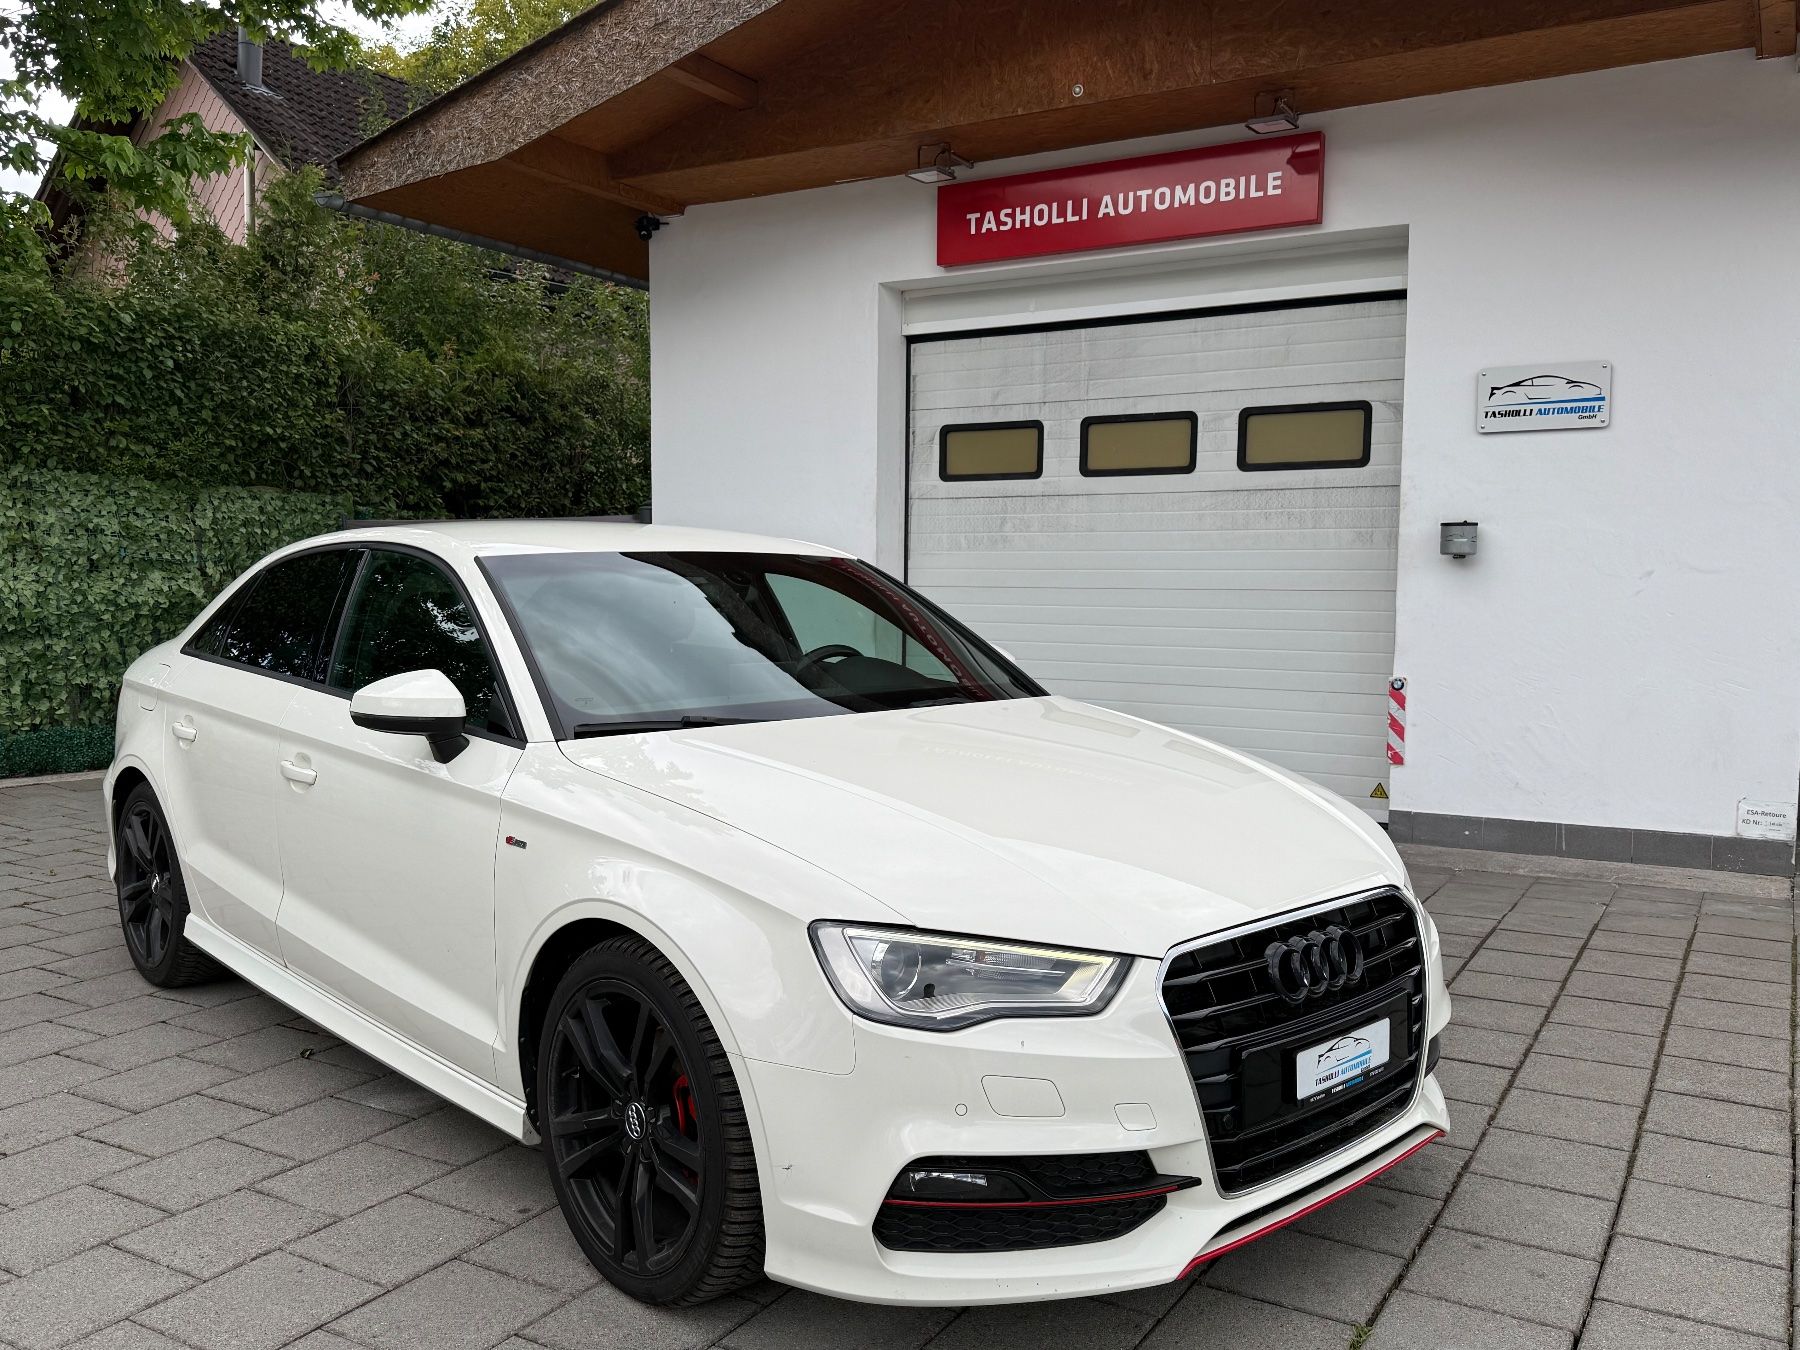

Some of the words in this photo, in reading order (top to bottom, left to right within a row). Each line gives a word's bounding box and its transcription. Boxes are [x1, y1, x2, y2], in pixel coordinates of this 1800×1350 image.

[966, 198, 1088, 235] TASHOLLI
[1098, 171, 1283, 218] AUTOMOBILE
[1484, 408, 1534, 419] TASHOLLI
[1535, 404, 1604, 416] AUTOMOBILE
